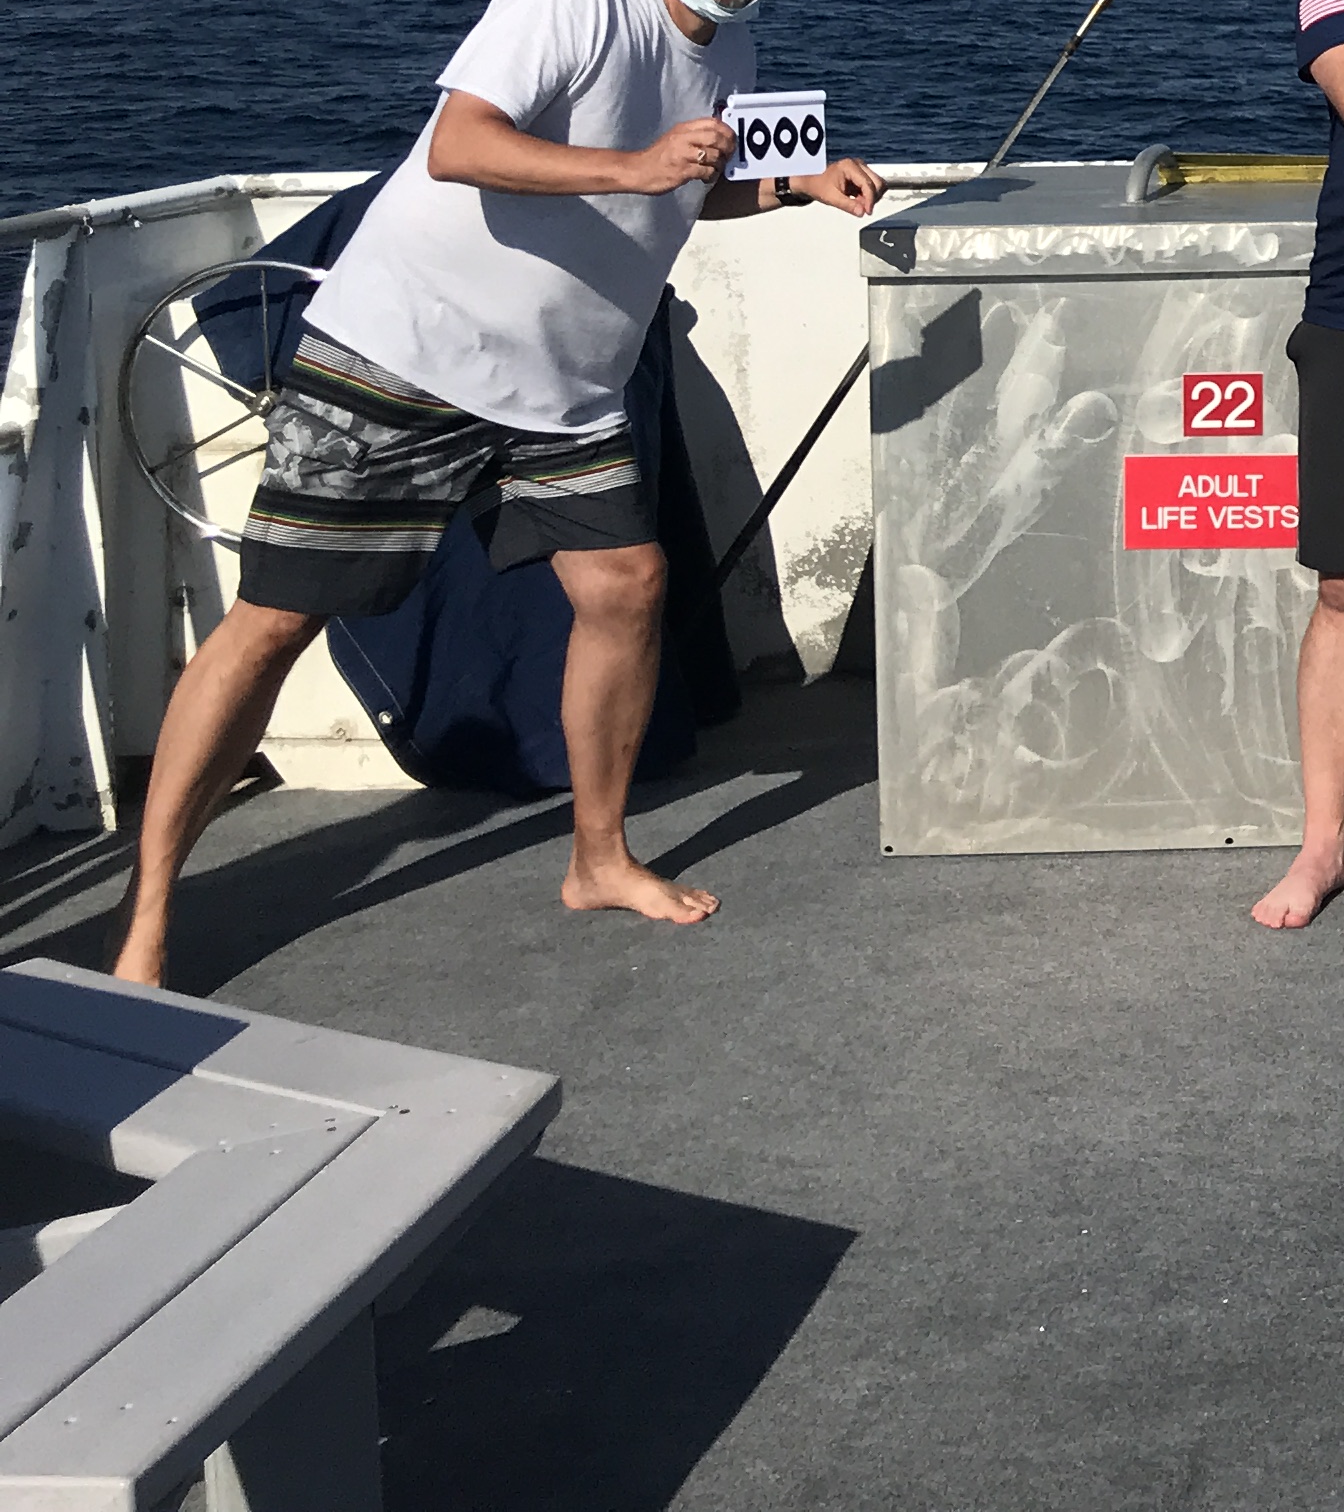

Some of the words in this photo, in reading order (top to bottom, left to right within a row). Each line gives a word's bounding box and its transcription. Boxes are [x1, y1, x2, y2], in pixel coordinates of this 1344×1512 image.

[737, 114, 824, 162] 1000
[1190, 381, 1255, 428] 22
[1178, 474, 1263, 498] ADULT
[1141, 506, 1197, 530] LIFE
[1207, 505, 1299, 529] VESTS
